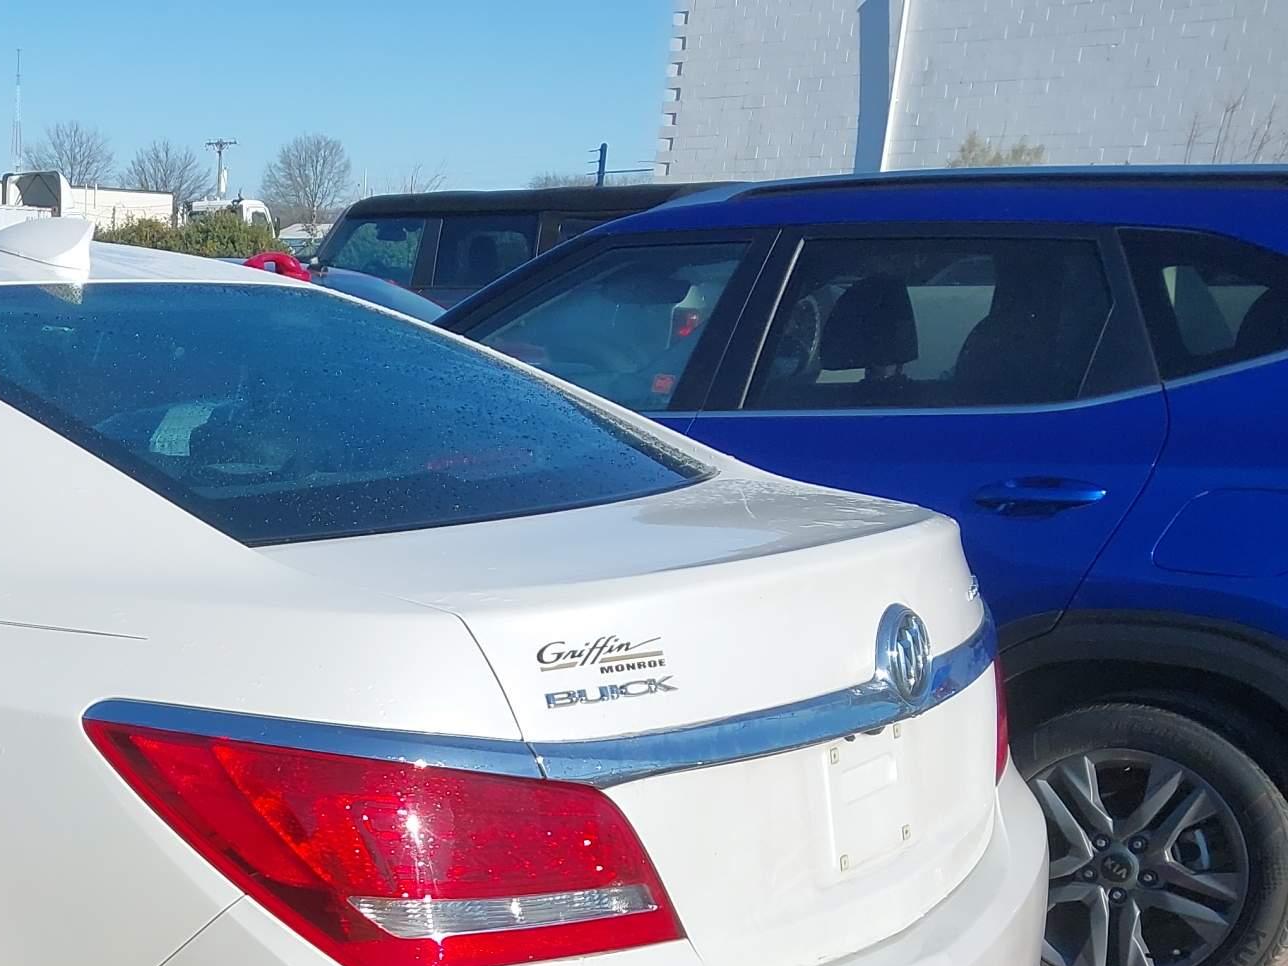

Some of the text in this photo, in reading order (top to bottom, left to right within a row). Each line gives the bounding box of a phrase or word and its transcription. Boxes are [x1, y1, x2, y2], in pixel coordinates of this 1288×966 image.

[536, 635, 662, 667] Griffin
[600, 658, 666, 674] MONROE
[544, 675, 679, 709] BUICK
[1104, 857, 1128, 879] KIA
